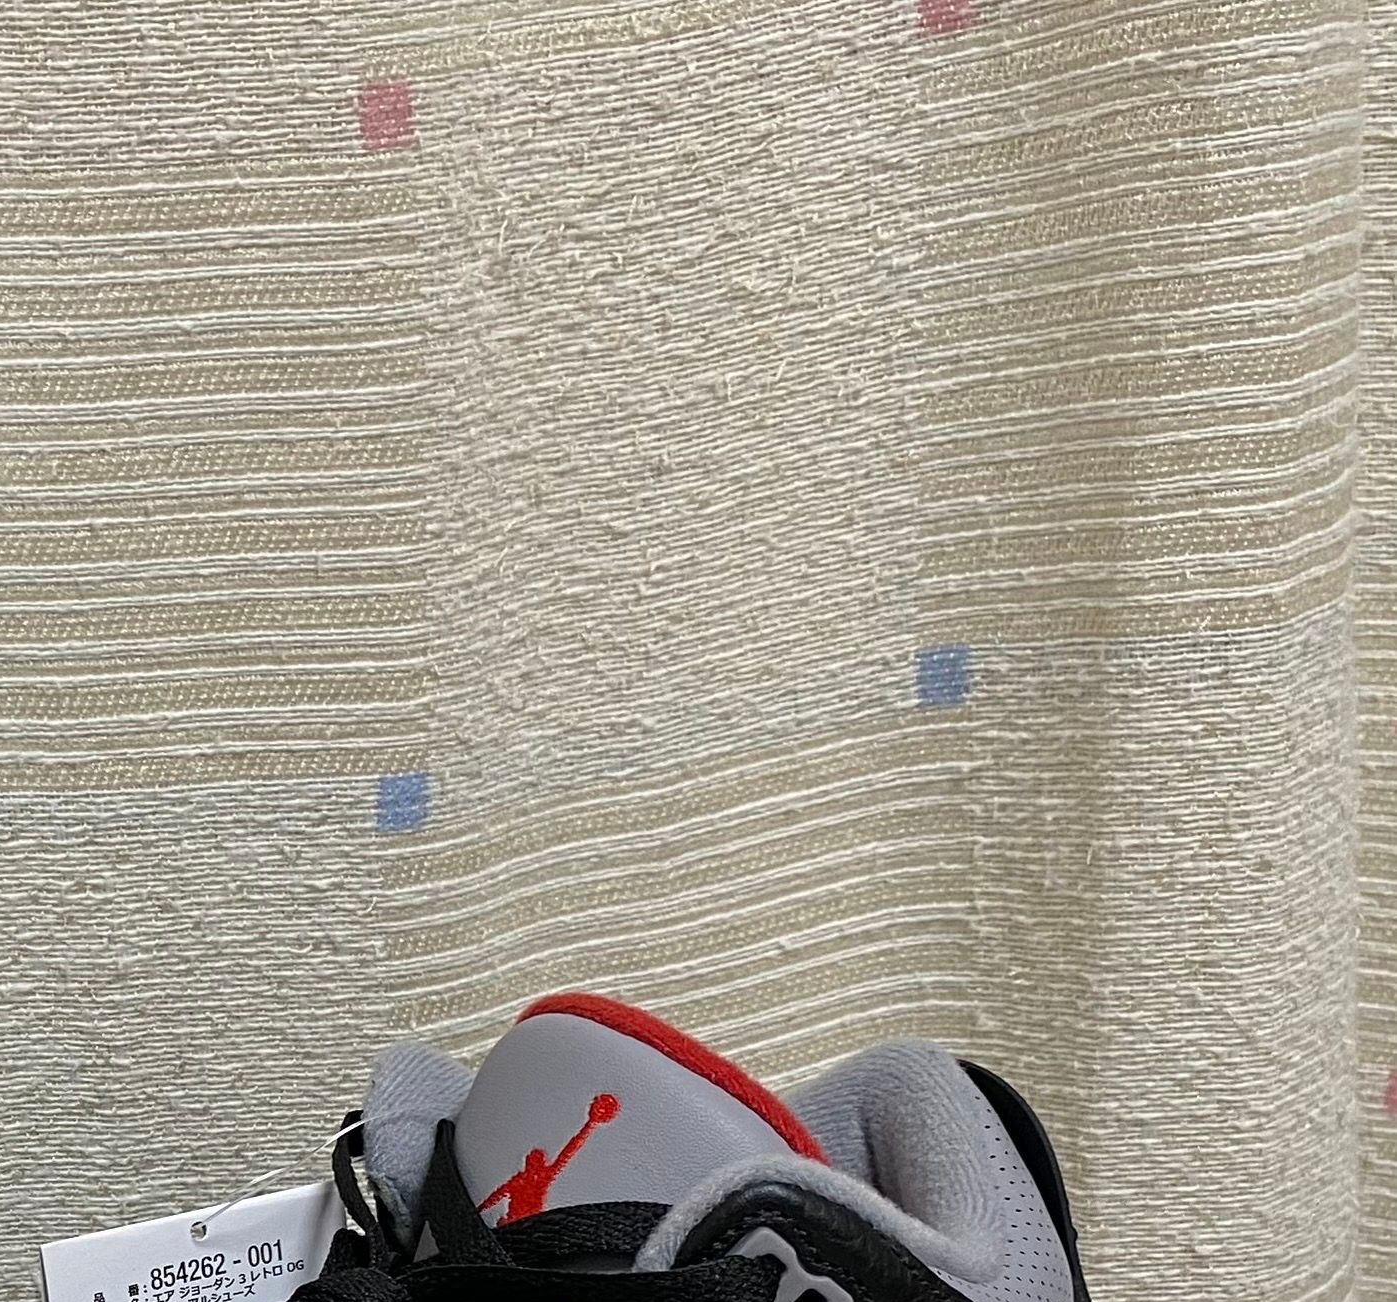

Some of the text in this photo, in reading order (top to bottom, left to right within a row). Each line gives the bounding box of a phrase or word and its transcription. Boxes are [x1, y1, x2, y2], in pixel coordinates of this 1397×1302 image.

[150, 1253, 227, 1290] 854262
[248, 1239, 283, 1267] 001
[287, 1260, 304, 1273] OG
